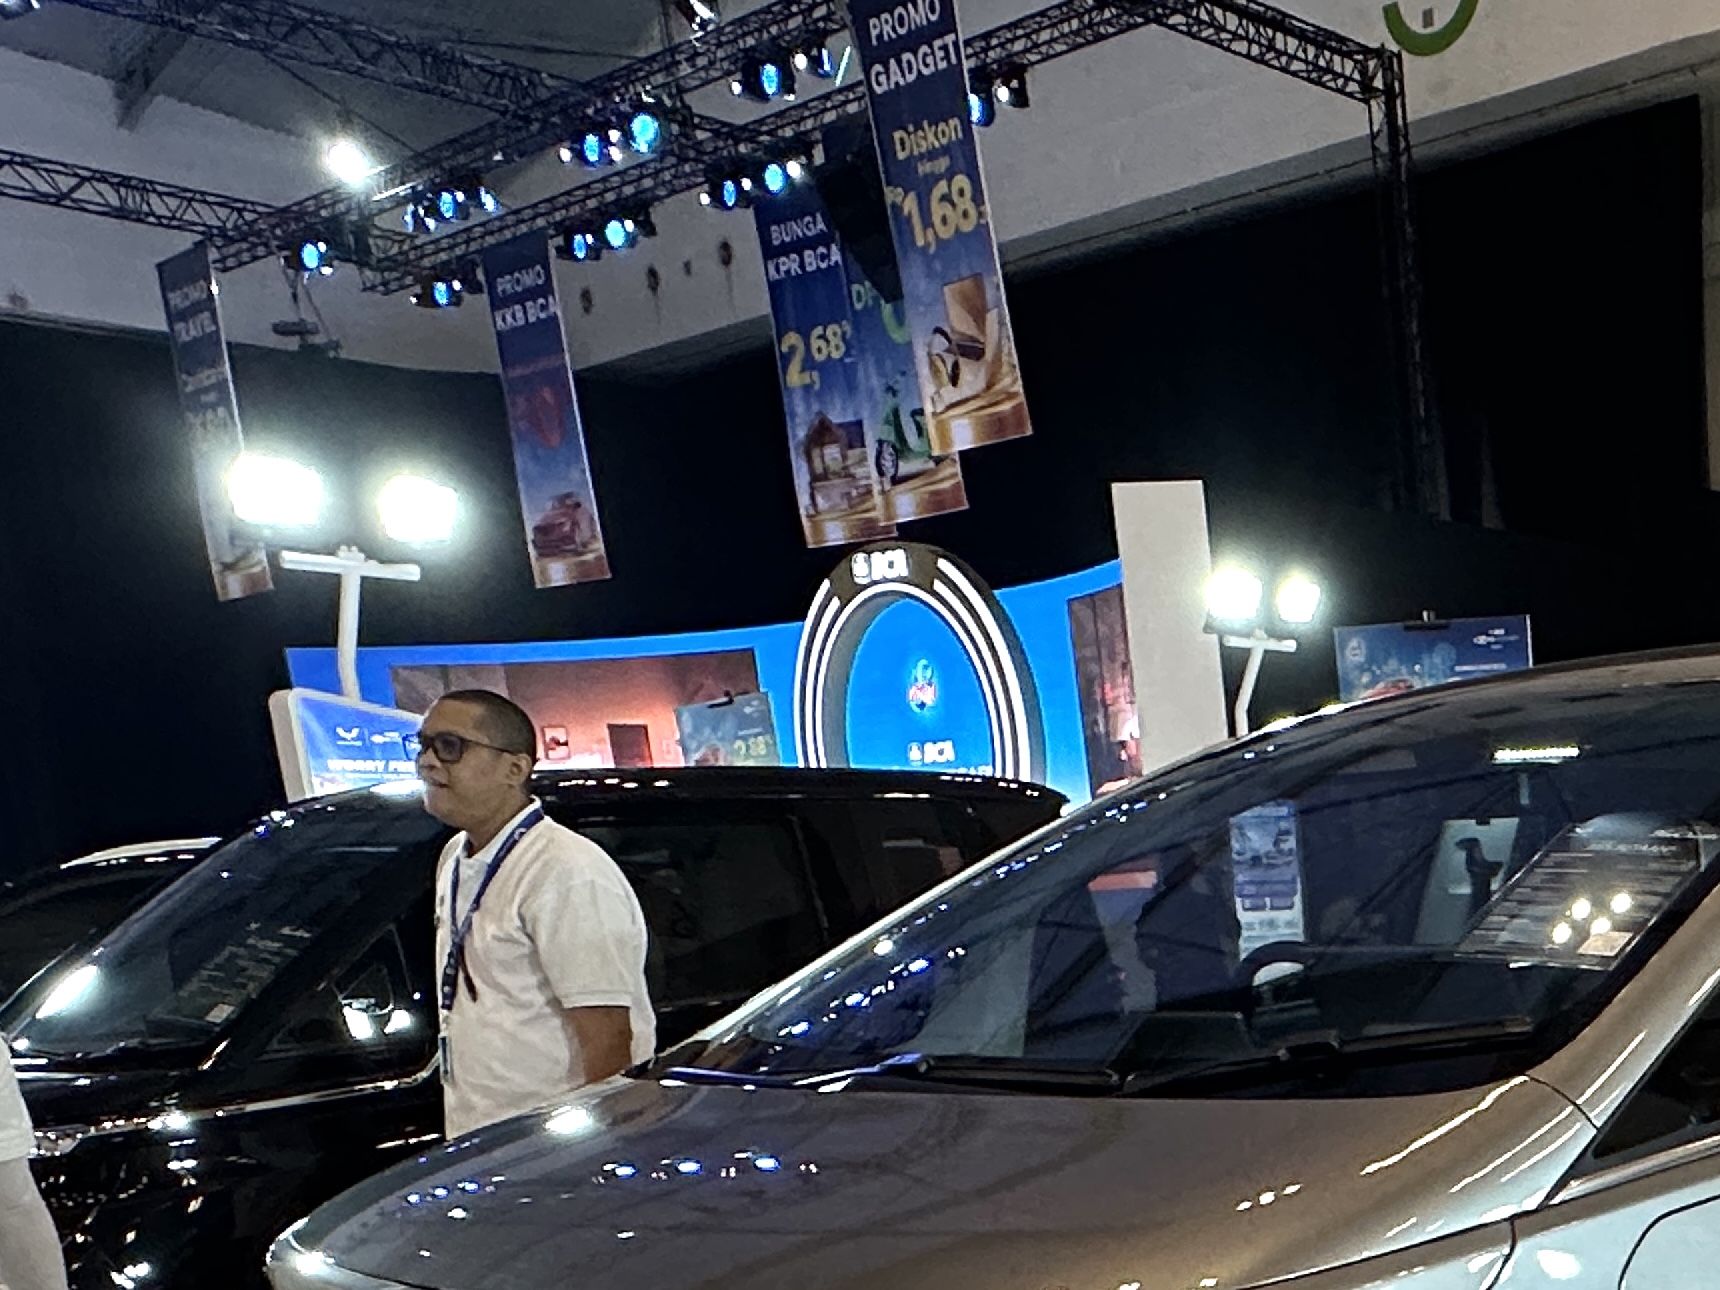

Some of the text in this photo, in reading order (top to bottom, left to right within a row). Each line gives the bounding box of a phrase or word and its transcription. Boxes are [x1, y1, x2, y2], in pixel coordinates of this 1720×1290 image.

[868, 0, 941, 46] PROMO
[869, 32, 957, 95] GADGET
[892, 117, 963, 161] Diskon
[770, 212, 828, 246] BUNGA
[496, 264, 546, 297] PROMO
[767, 243, 842, 281] KPR BCA
